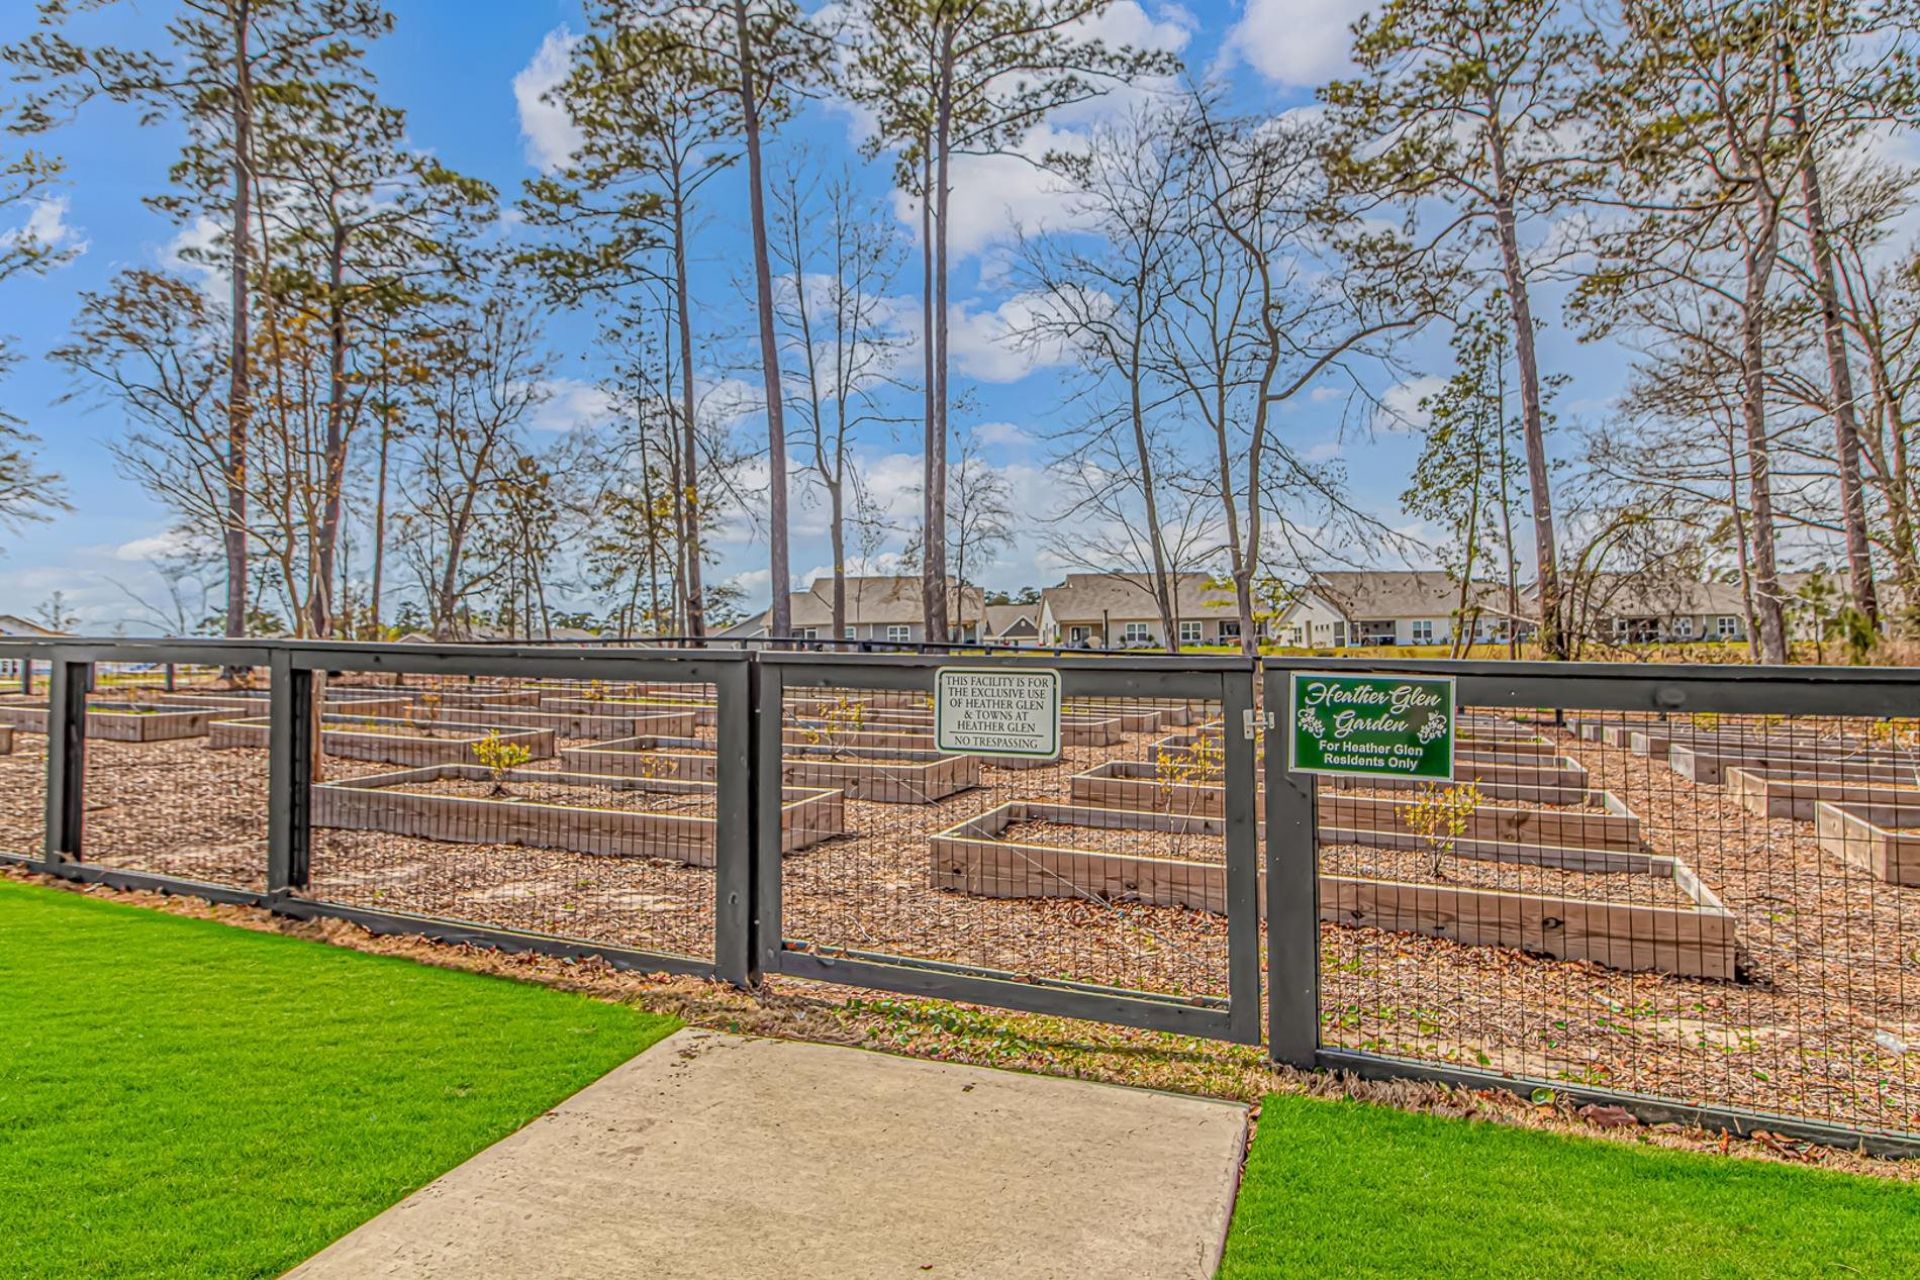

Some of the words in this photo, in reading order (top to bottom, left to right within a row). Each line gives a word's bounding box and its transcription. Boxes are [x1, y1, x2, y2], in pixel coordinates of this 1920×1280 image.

[946, 676, 967, 685] THIS
[971, 677, 1015, 687] FACILITY
[1017, 678, 1025, 687] IS
[1028, 678, 1048, 687] FOR
[948, 687, 968, 696] THE
[971, 688, 1024, 698] EXCLUSIVE
[1028, 689, 1045, 699] USE
[1305, 682, 1389, 707] Heather
[1389, 686, 1441, 714] Glen
[950, 698, 962, 708] OF
[966, 699, 1013, 709] HEATHER
[1016, 701, 1044, 710] GLEN
[964, 711, 972, 719] &
[976, 710, 1012, 720] TOWNS
[1016, 711, 1029, 720] AT
[957, 721, 1004, 731] HEATHER
[1007, 723, 1035, 732] GLEN
[1333, 710, 1408, 738] Garden
[955, 736, 970, 745] NO
[973, 737, 1038, 749] TRESPASSING
[1319, 740, 1340, 751] For
[1343, 742, 1389, 754] Heather
[1394, 744, 1423, 756] Glen
[1324, 753, 1384, 766] Residents
[1388, 757, 1418, 771] Only
